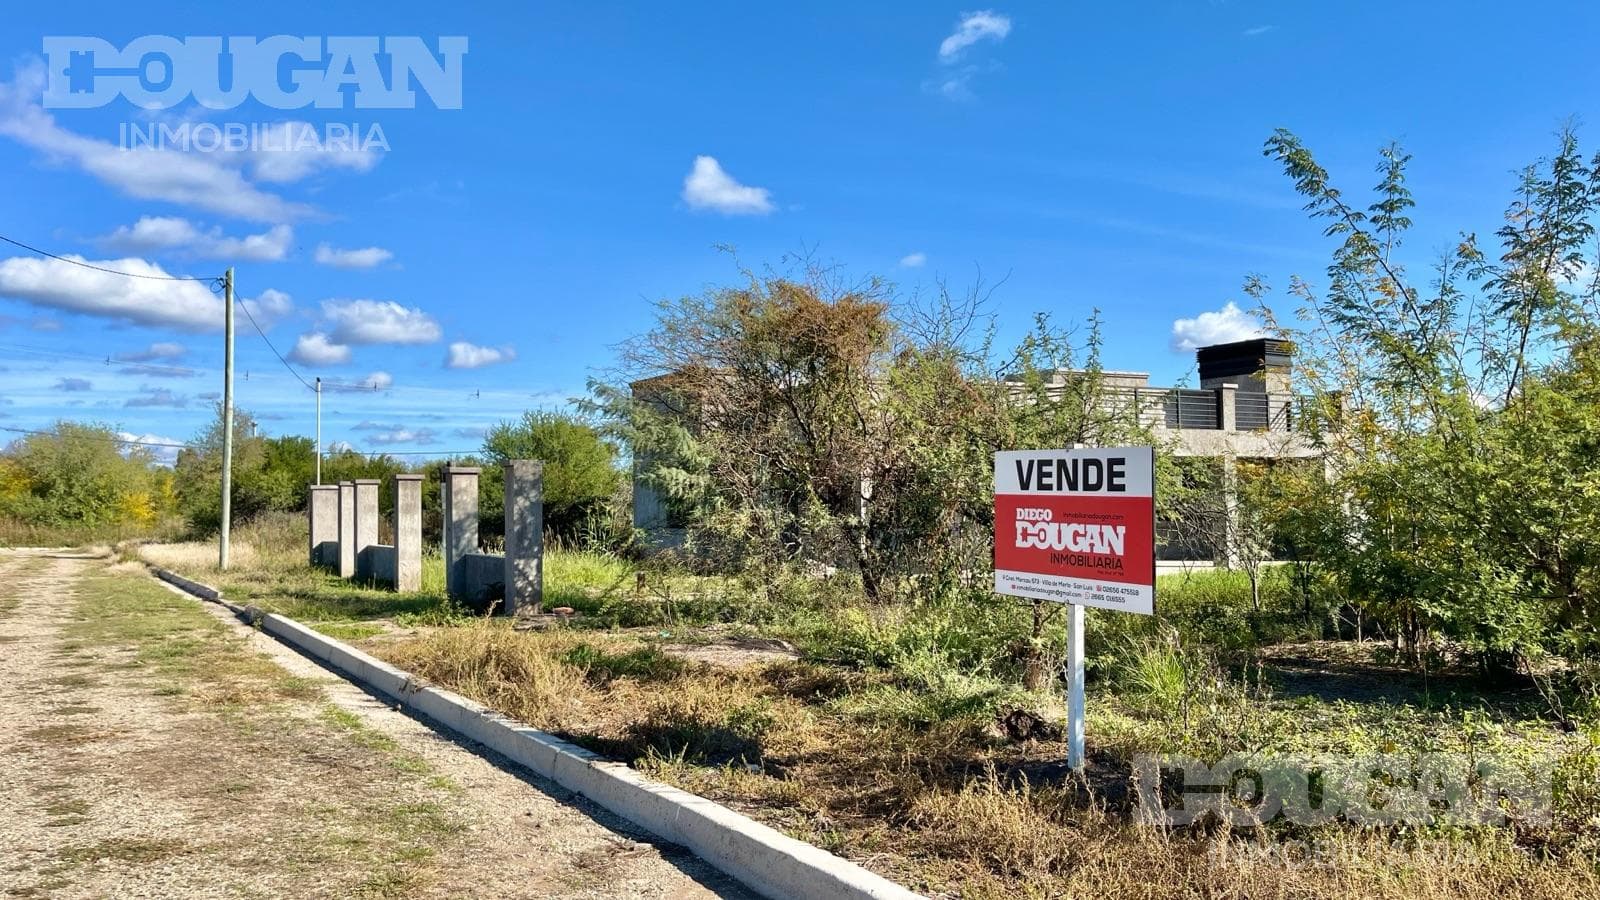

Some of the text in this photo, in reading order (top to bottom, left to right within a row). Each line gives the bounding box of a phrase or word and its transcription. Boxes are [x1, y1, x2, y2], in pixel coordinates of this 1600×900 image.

[1016, 457, 1126, 492] VENDE
[1016, 507, 1053, 521] DIEGO
[1016, 520, 1126, 556] DOUGAN
[1050, 552, 1124, 570] INMOBILIARIA
